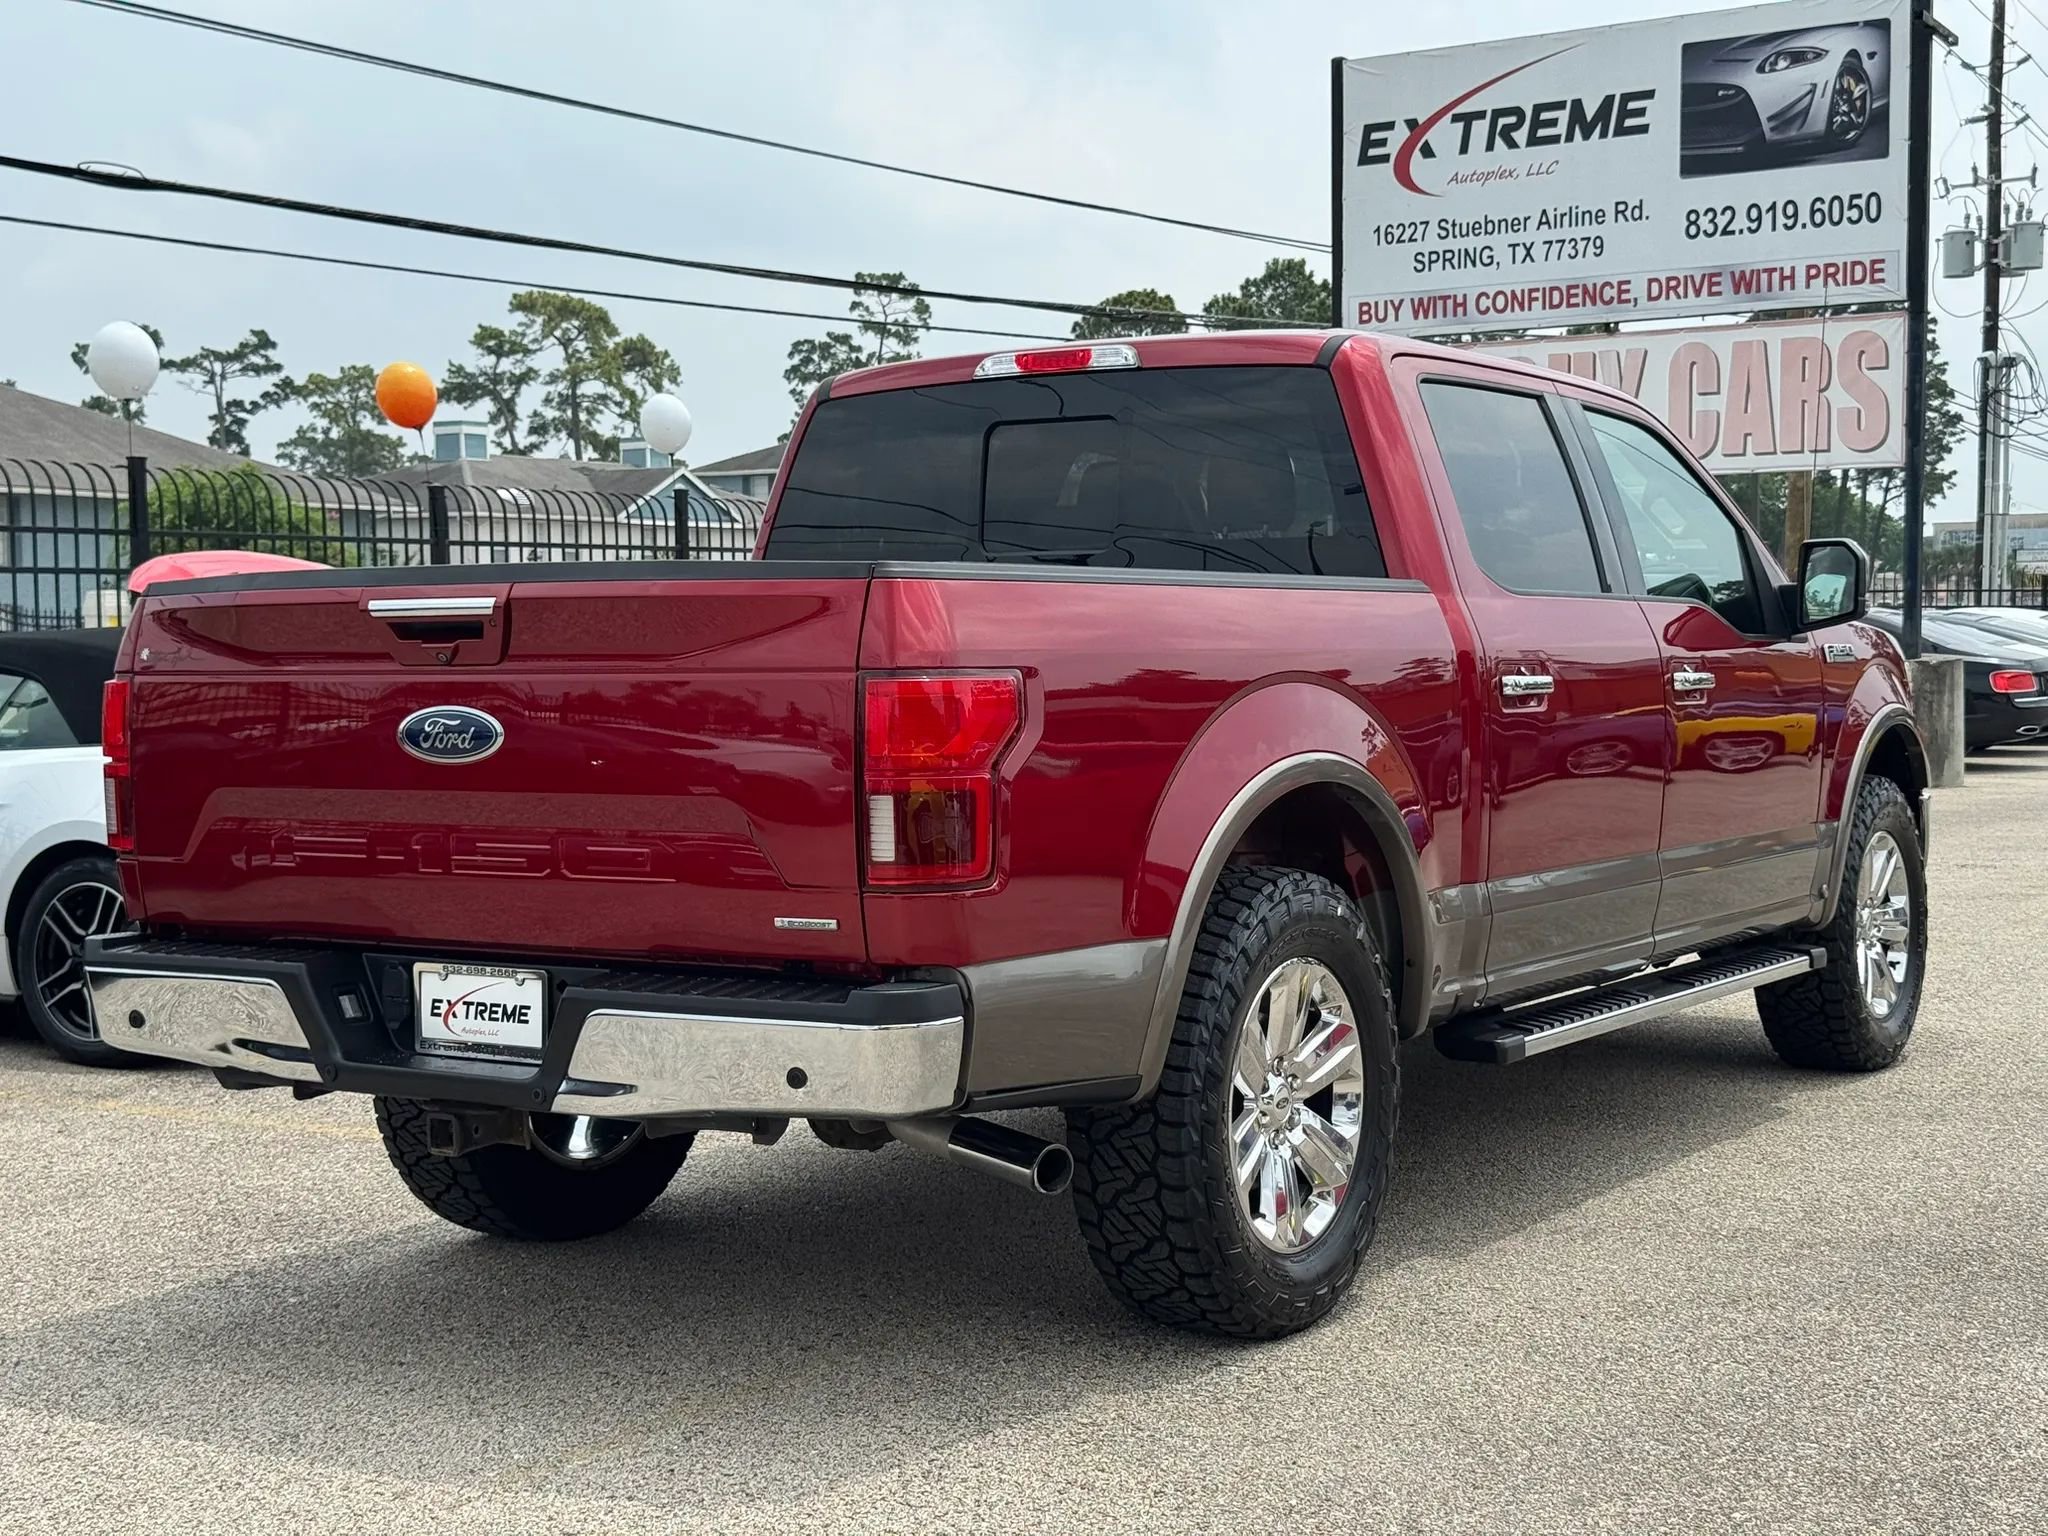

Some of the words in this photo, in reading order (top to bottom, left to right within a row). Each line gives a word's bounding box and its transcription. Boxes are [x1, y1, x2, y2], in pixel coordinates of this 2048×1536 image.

[1356, 87, 1656, 167] EXTREME
[1446, 164, 1520, 187] Autoplex,
[1525, 159, 1560, 178] LLC
[1373, 220, 1430, 246] 16227
[1436, 213, 1531, 241] Stuebner
[1535, 204, 1607, 232] Airline
[1613, 198, 1650, 224] Rd.
[1684, 191, 1882, 240] 832.919.6050
[1412, 244, 1501, 274] SPRING,
[1507, 240, 1536, 265] TX
[1541, 234, 1604, 263] 77379
[1357, 298, 1405, 326] BUY
[1409, 292, 1468, 321] WITH
[1474, 279, 1639, 316] CONFIDENCE,
[1646, 271, 1723, 303] DRIVE
[1729, 265, 1796, 296] WITH
[1804, 258, 1886, 290] PRIDE
[1668, 330, 1891, 461] CARS
[419, 717, 476, 750] Ford
[430, 997, 532, 1025] EXTREME
